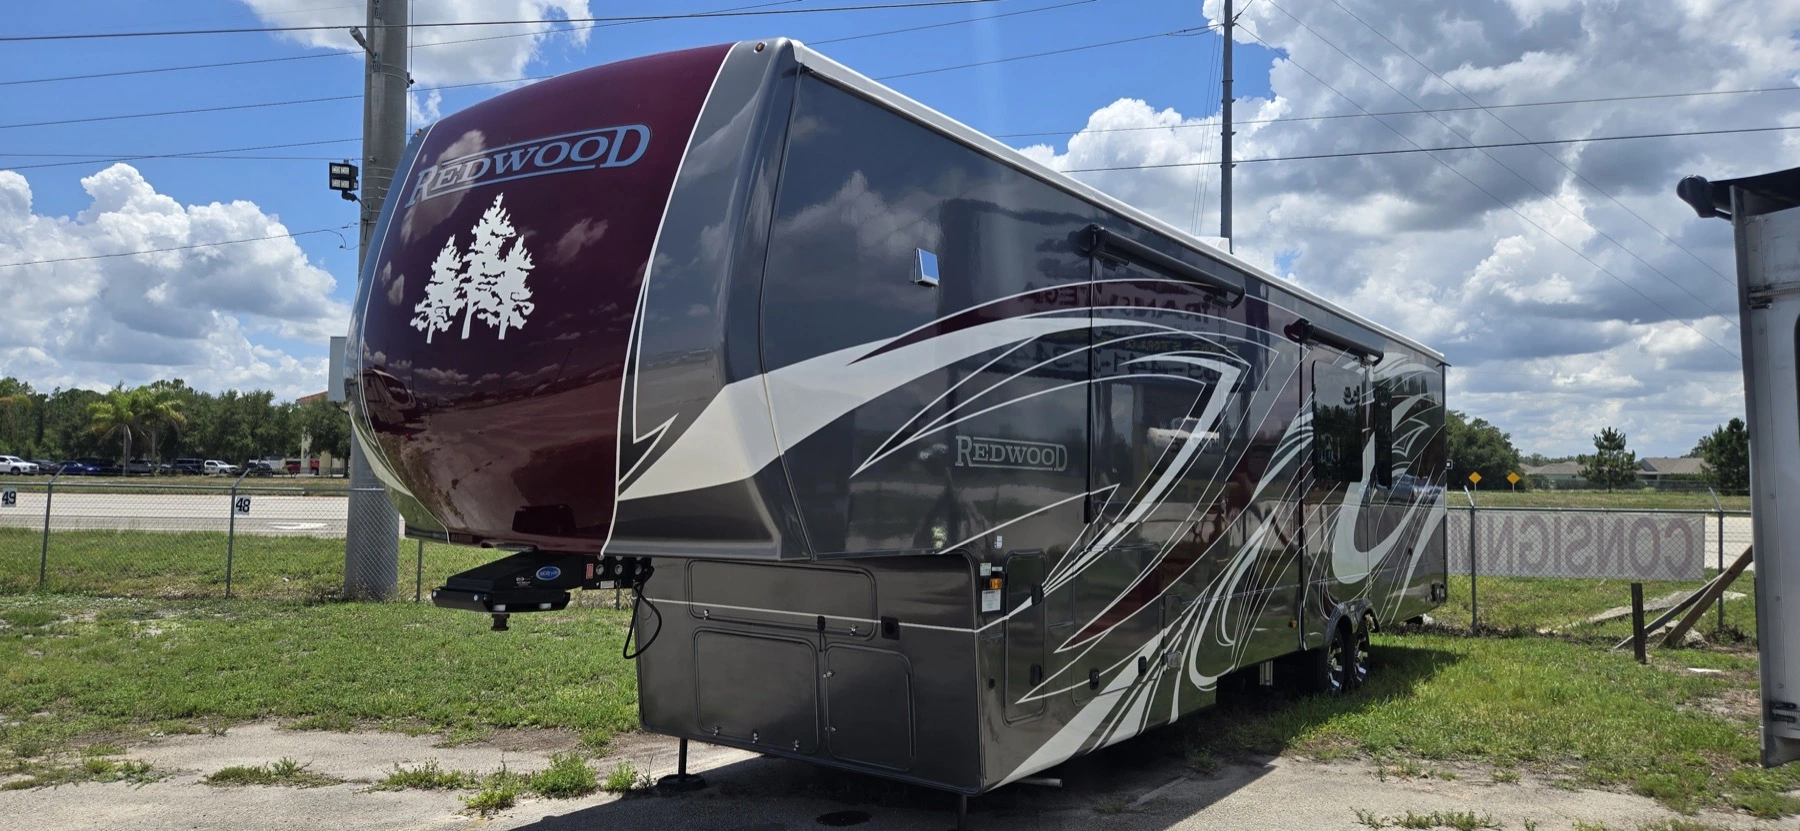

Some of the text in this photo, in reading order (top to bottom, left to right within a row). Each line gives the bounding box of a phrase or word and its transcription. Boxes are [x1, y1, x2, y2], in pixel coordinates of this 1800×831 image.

[406, 124, 652, 208] REDWOOD
[955, 436, 1068, 472] REDWOOD
[2, 491, 17, 505] 49
[235, 497, 251, 513] 48
